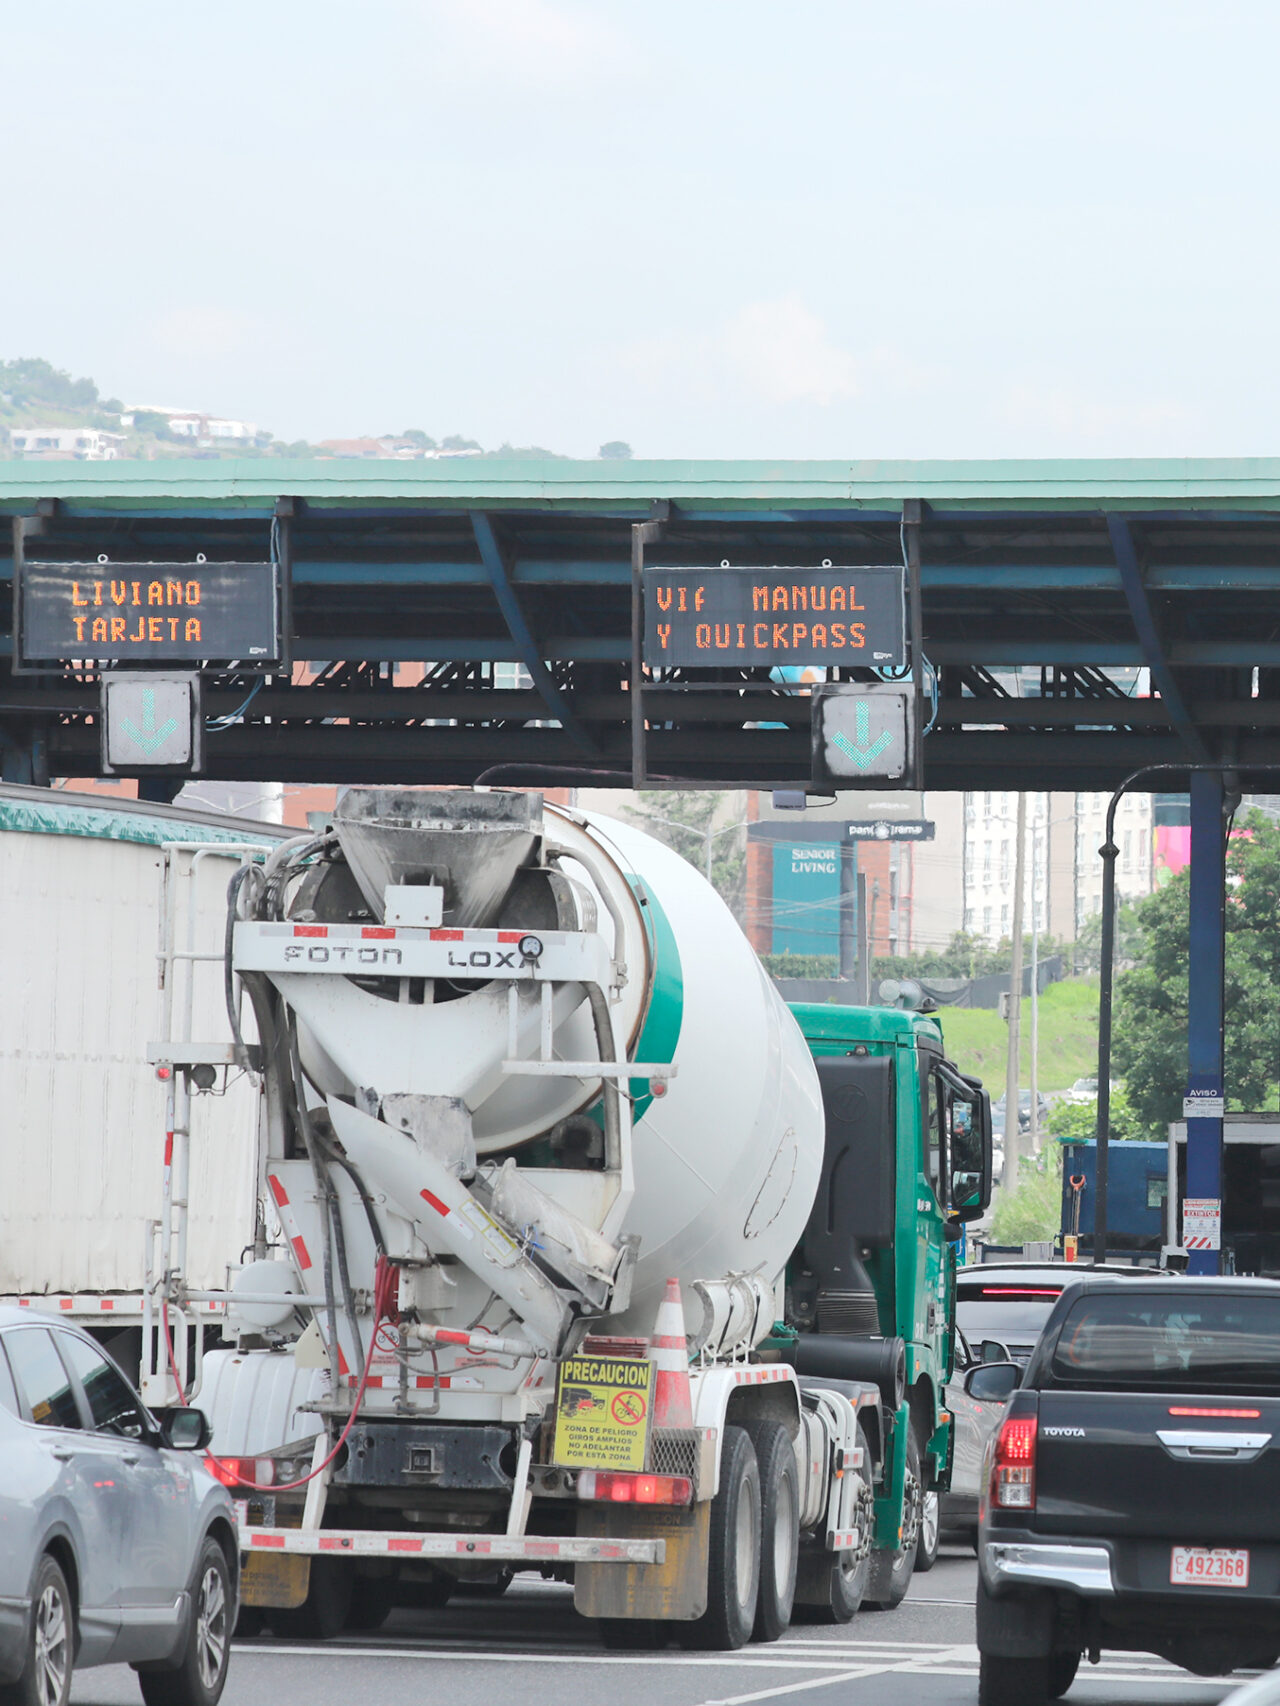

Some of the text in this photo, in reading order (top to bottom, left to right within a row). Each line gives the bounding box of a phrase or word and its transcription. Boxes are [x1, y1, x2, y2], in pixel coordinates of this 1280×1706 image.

[72, 580, 201, 606] LIVIANO
[752, 585, 865, 611] MANUAL
[72, 616, 202, 642] TARJETA
[657, 623, 866, 649] Y QUICKPASS
[792, 849, 836, 860] SENIOR
[791, 862, 836, 874] LIVING
[284, 945, 402, 965] FOTON
[1190, 1089, 1217, 1097] AVISO
[564, 1361, 648, 1386] PRECAUCION
[564, 1425, 638, 1437] ZONA DE PELIGRO
[1043, 1426, 1086, 1438] TOYOTA
[568, 1434, 632, 1445] GIROS AMPLIOS
[583, 1443, 631, 1452] ADELANTAR
[586, 1452, 606, 1460] ESTA
[609, 1453, 631, 1461] ZONA
[1185, 1556, 1244, 1577] 492368
